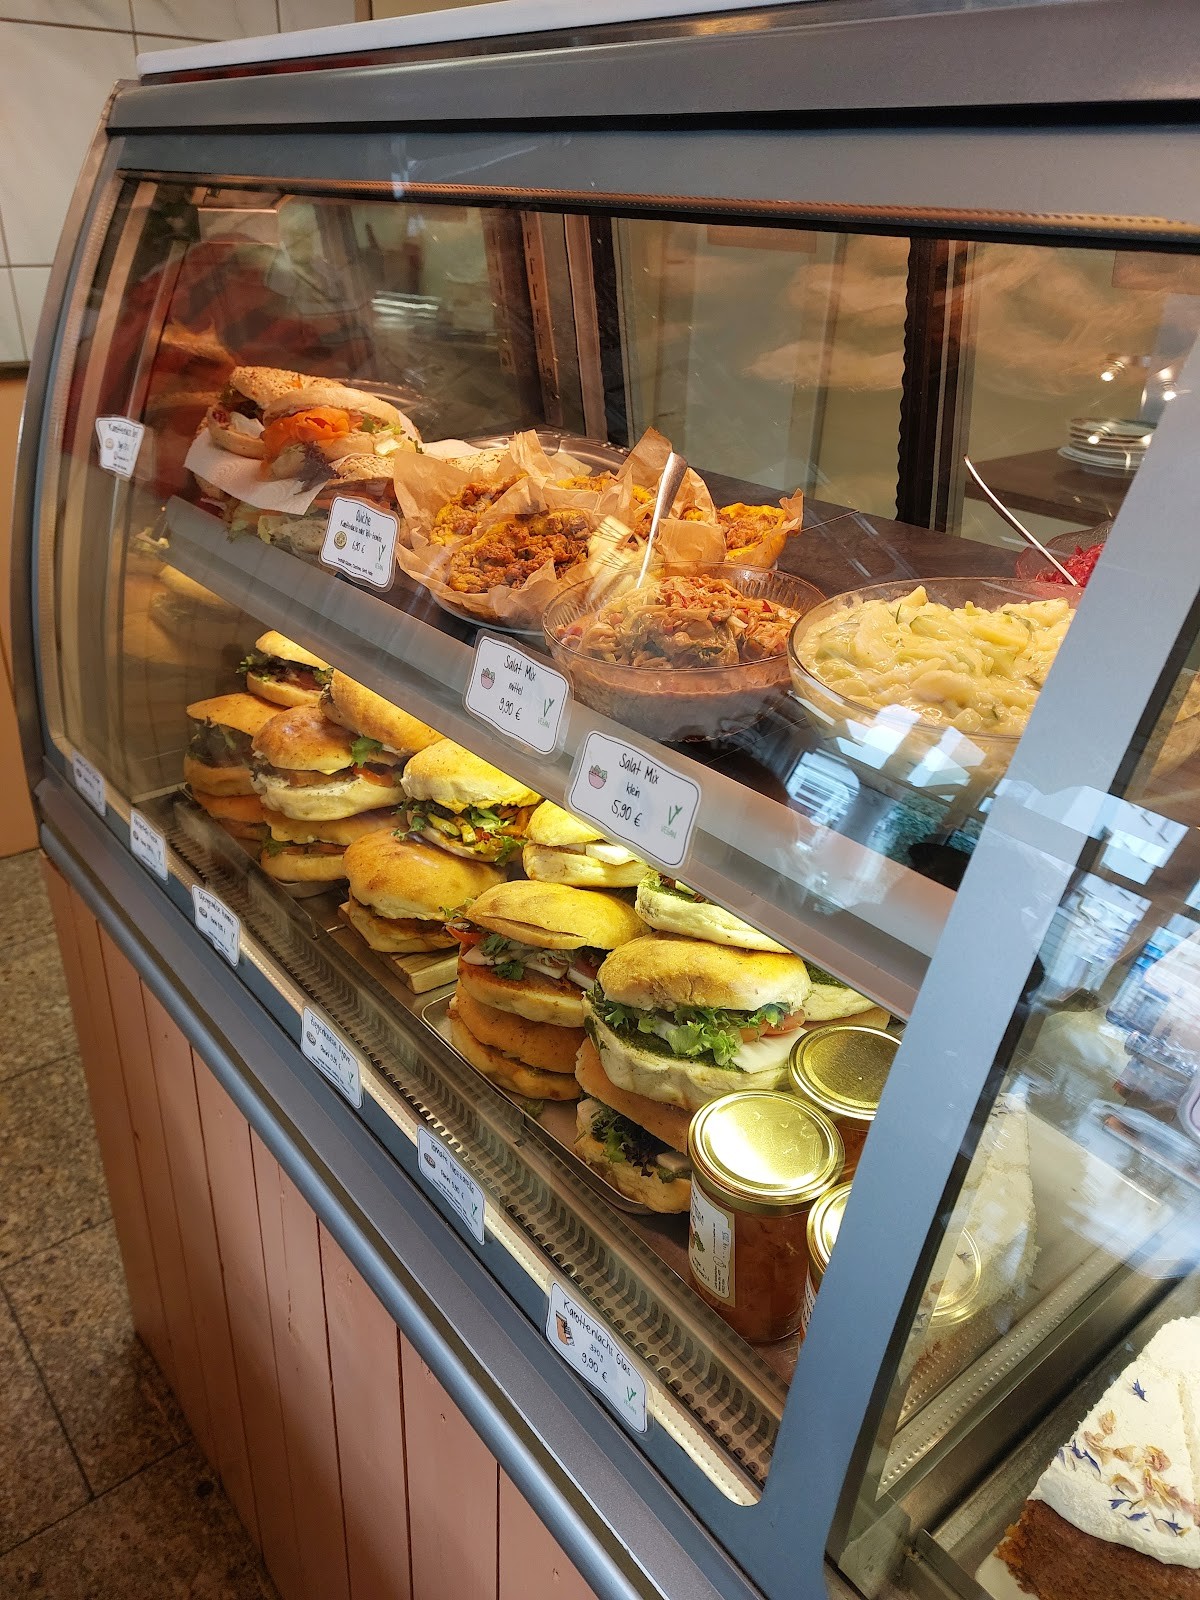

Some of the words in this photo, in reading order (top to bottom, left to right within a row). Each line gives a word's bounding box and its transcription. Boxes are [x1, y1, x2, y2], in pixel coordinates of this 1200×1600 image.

[503, 654, 523, 675] Salat
[524, 665, 537, 682] Mix
[508, 682, 524, 696] mittel
[498, 697, 514, 716] 9,90
[515, 707, 522, 721] €
[619, 753, 642, 776] Salat
[644, 766, 660, 785] Mix
[611, 799, 632, 820] 5,90
[634, 813, 643, 827] €
[563, 1298, 614, 1358] Karottenlachs
[615, 1353, 631, 1377] Glas
[581, 1352, 599, 1374] 9,90
[601, 1371, 608, 1384] €
